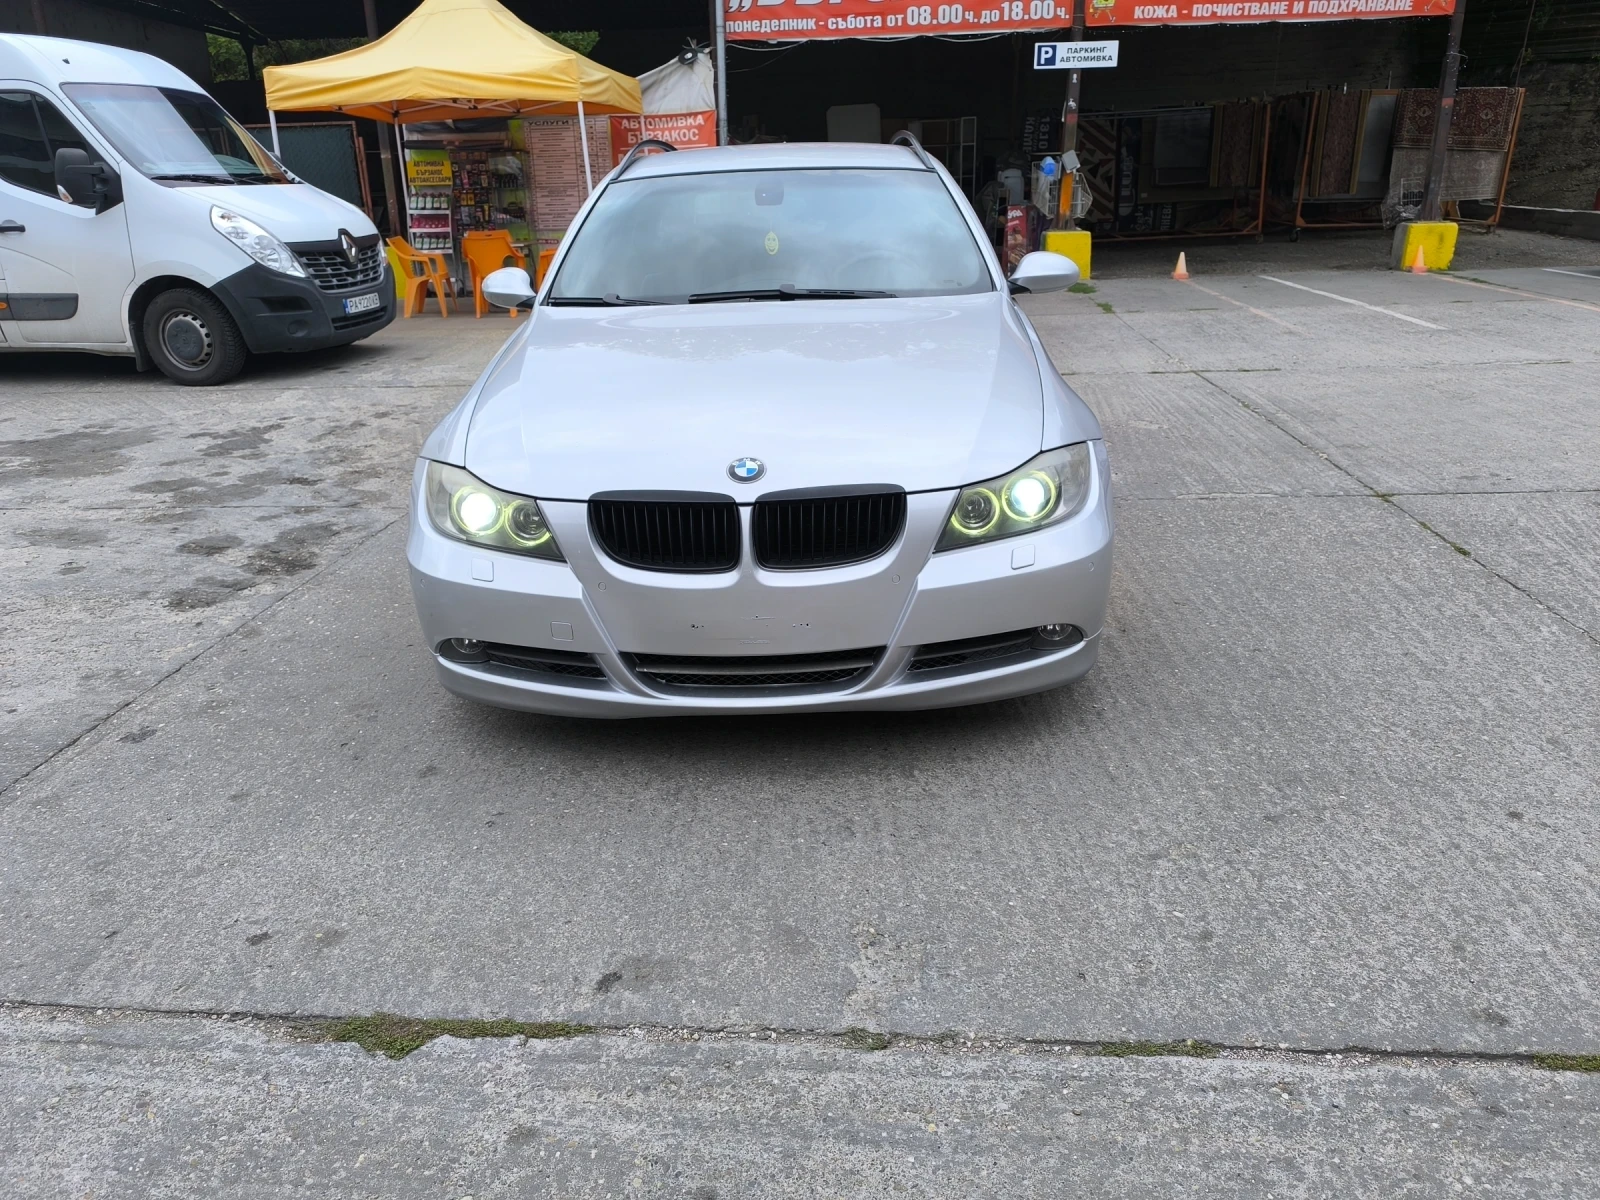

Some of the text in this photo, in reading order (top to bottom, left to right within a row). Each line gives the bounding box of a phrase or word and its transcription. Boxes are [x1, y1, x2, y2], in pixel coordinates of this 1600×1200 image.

[726, 18, 816, 33] понеделник
[828, 14, 882, 30] събота
[886, 14, 904, 27] от
[906, 4, 963, 26] 08.00
[965, 11, 978, 23] ч.
[980, 10, 1000, 24] до
[1001, 0, 1055, 21] 18.00
[1056, 7, 1070, 19] ч.
[1133, 5, 1178, 19] КОЖА
[1192, 1, 1289, 17] ПОЧИСТВАНЕ
[1292, 1, 1304, 14] И
[1307, 0, 1414, 15] ПОДХРАНВАНЕ
[1040, 47, 1054, 65] P
[1060, 55, 1113, 63] АВТОМИВКА
[1066, 46, 1108, 54] ПАРКИНГ
